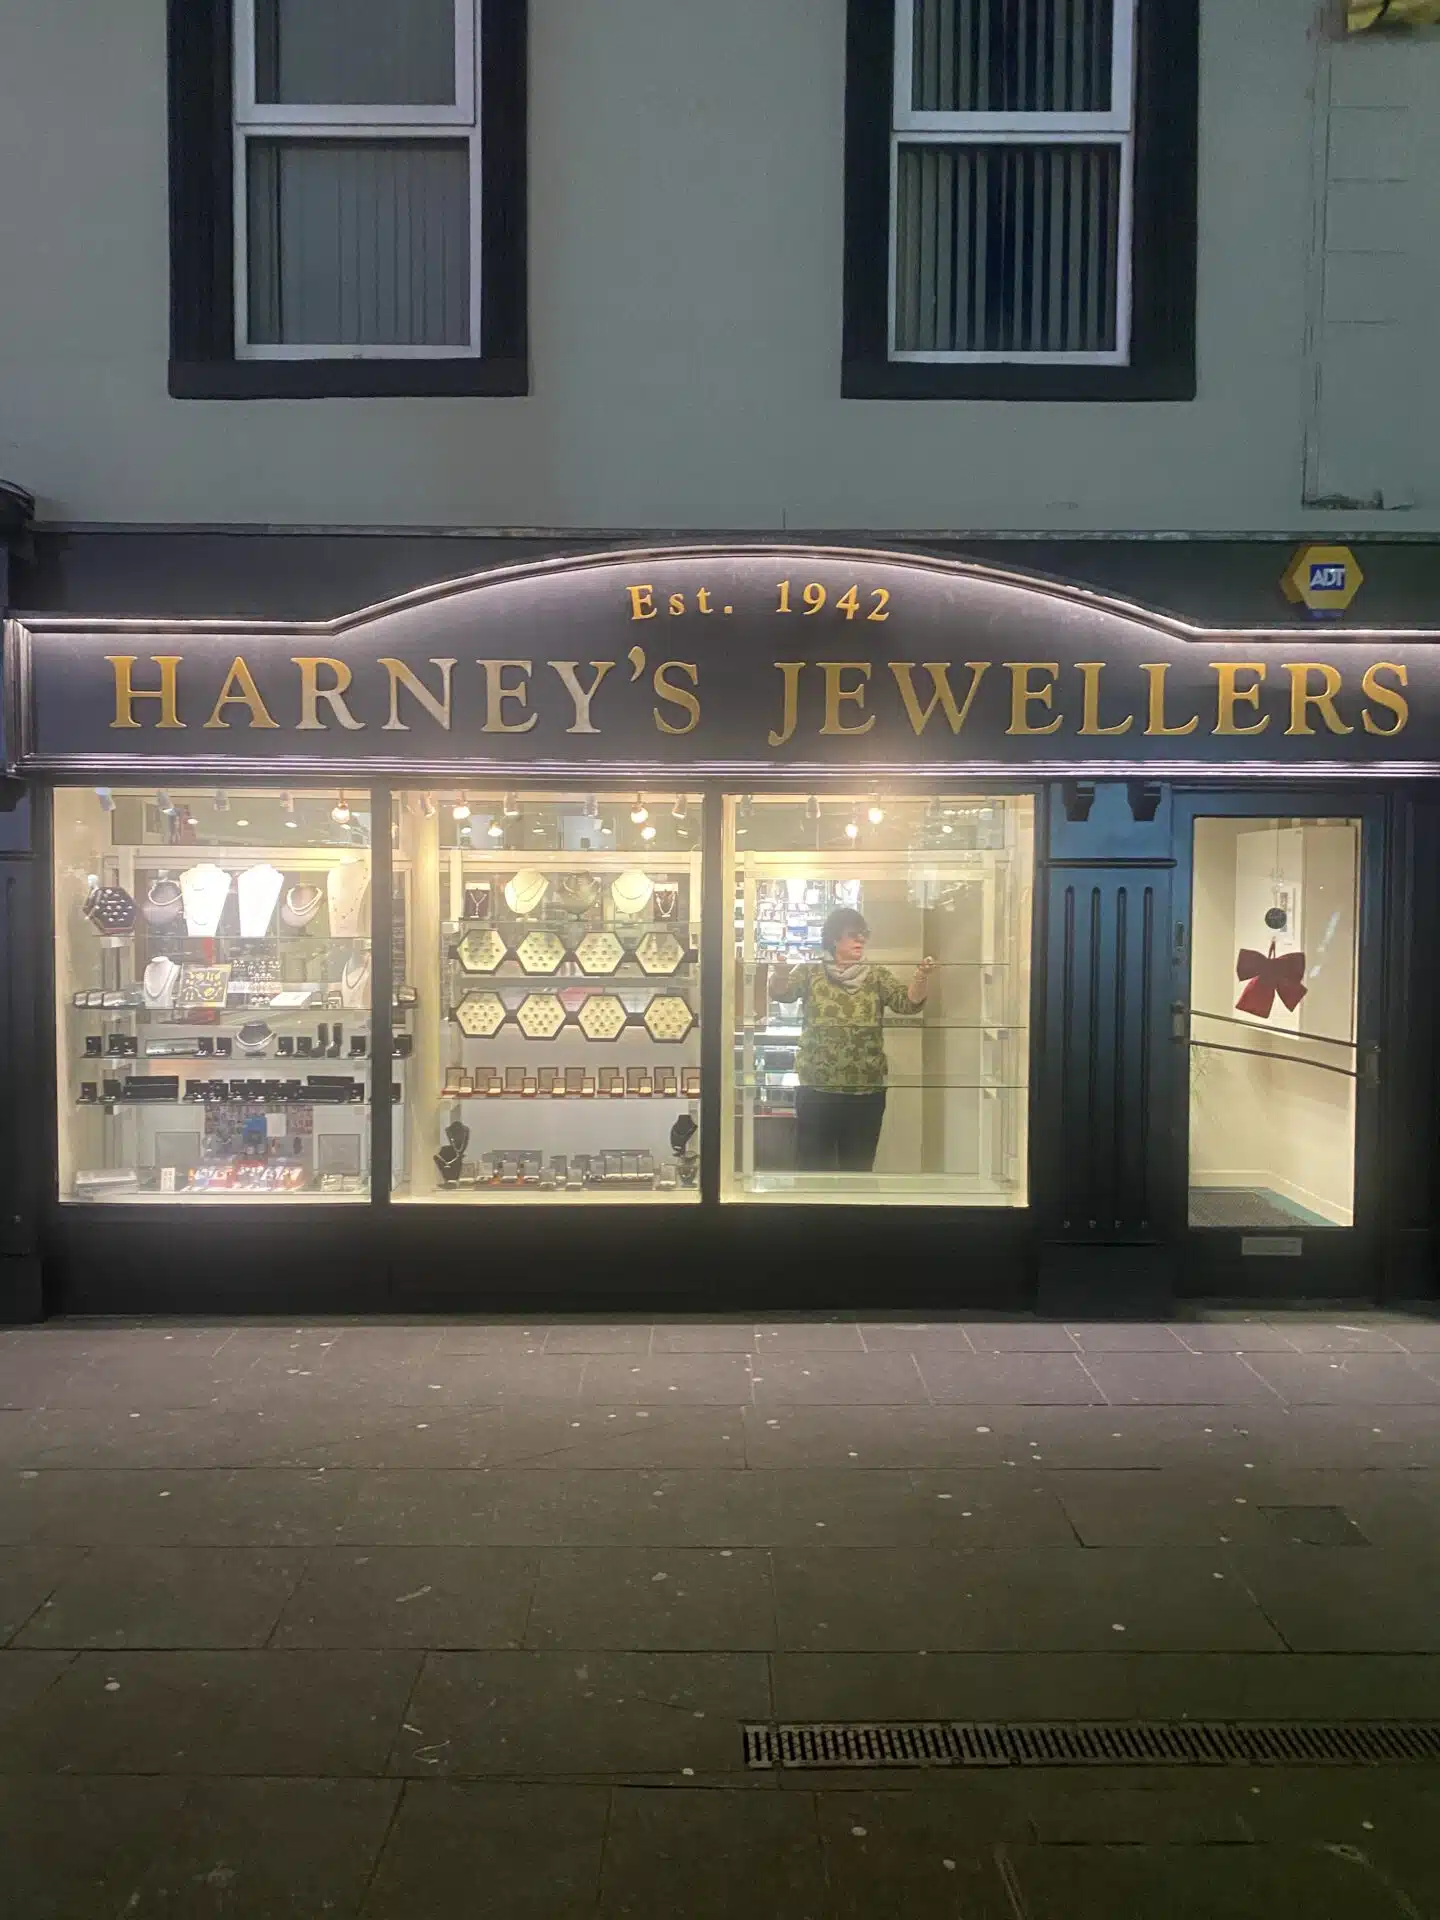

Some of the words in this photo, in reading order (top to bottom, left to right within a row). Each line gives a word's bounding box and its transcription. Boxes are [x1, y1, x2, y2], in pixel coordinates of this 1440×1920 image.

[1310, 567, 1346, 587] ADT
[627, 584, 734, 620] Est.
[776, 580, 890, 621] 1942
[104, 646, 701, 735] HARNEY'S
[768, 661, 1409, 747] JEWELLERS
